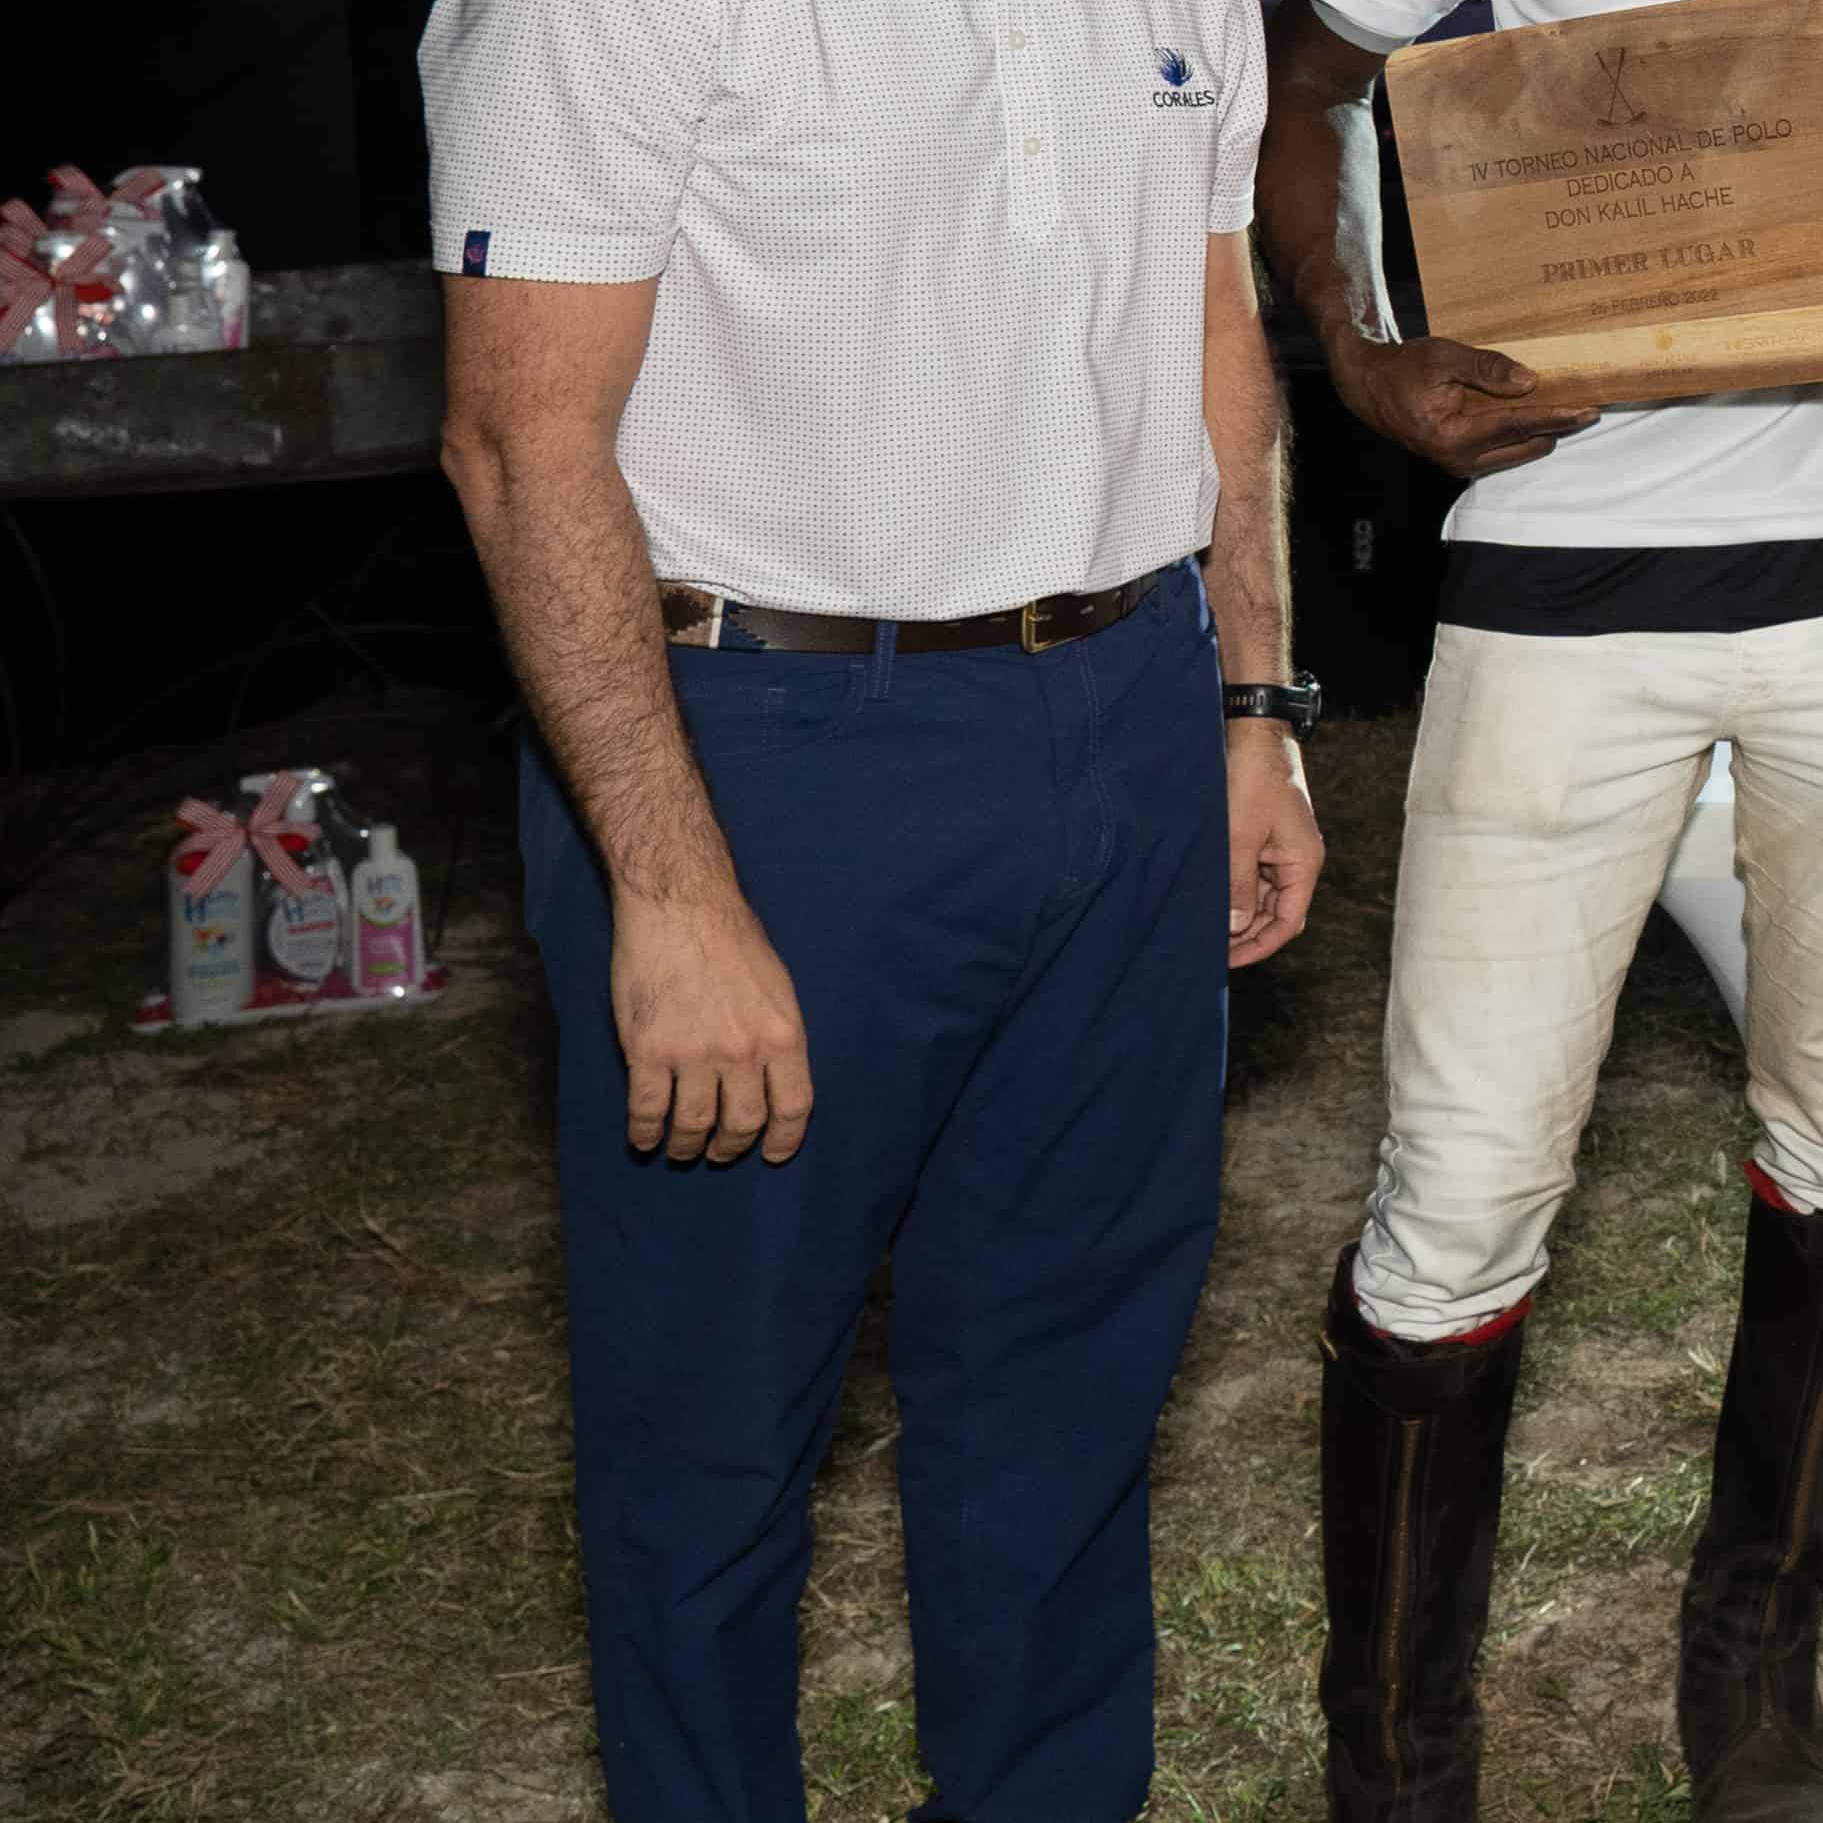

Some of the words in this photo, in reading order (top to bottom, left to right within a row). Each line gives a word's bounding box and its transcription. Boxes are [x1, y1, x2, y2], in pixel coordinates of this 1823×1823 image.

[1152, 90, 1216, 108] CORALES
[1470, 162, 1489, 181] IV
[1496, 150, 1578, 178] TORNEO
[1584, 136, 1693, 165] NACIONAL
[1696, 128, 1726, 149] DE
[1731, 118, 1793, 145] POLO
[1567, 165, 1673, 197] DEDICADO
[1680, 162, 1696, 181] A
[1544, 207, 1591, 229] DON
[1598, 196, 1656, 221] KALIL
[1661, 186, 1735, 213] HACHE
[1541, 251, 1649, 284] PRIMER
[1656, 238, 1756, 268] LUGAR
